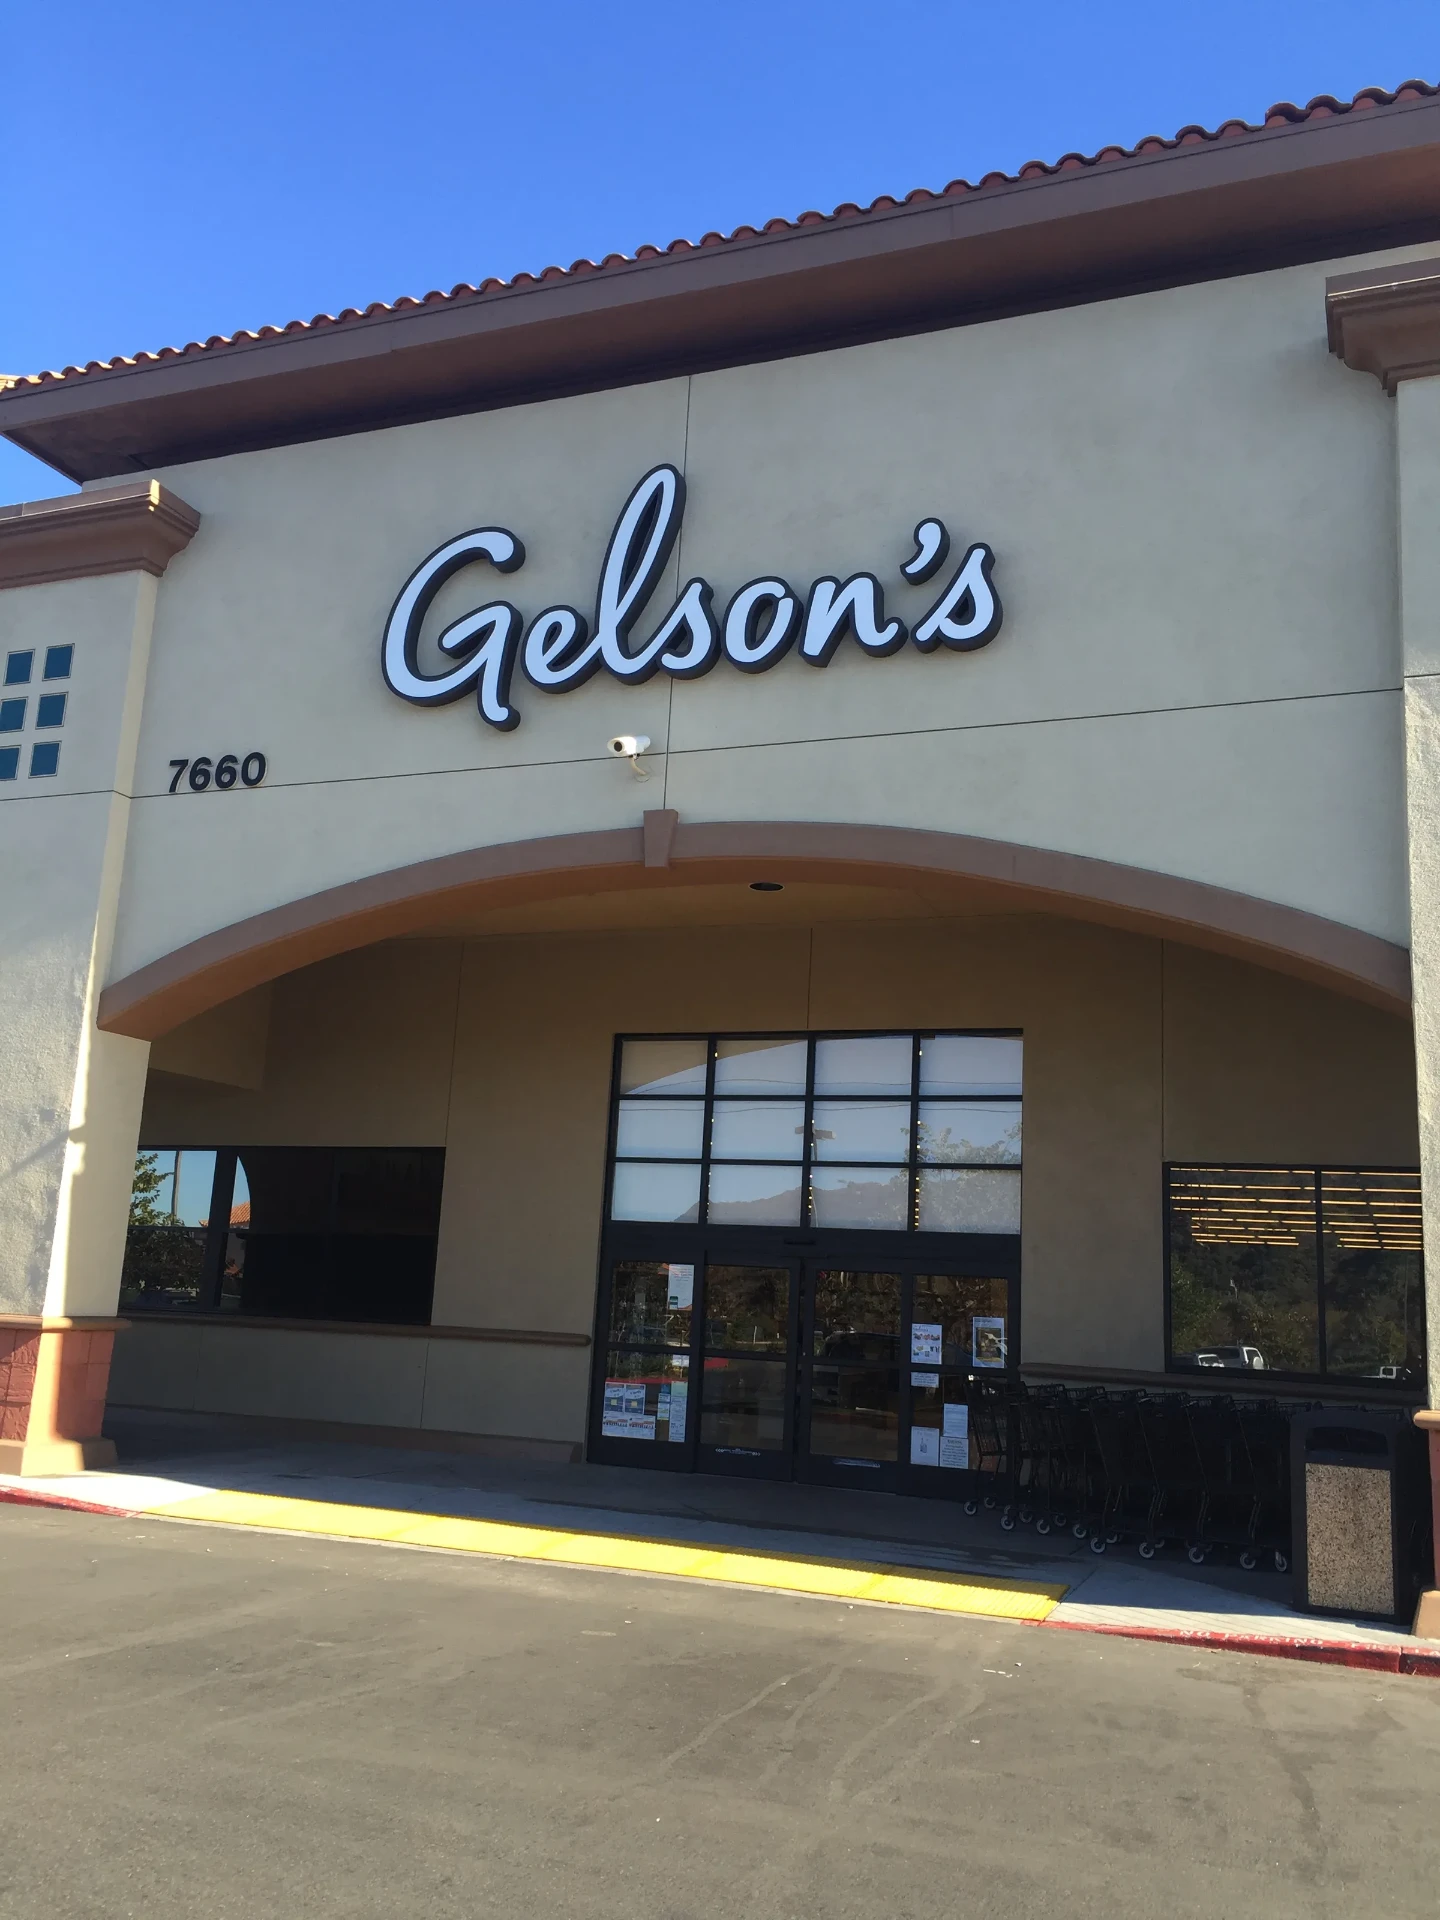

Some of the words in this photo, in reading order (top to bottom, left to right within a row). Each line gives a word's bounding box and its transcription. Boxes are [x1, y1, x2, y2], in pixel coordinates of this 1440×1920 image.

[382, 463, 1003, 731] Gelson's
[169, 752, 267, 793] 7660
[1179, 1629, 1211, 1638] NO
[1224, 1632, 1324, 1645] PARKING
